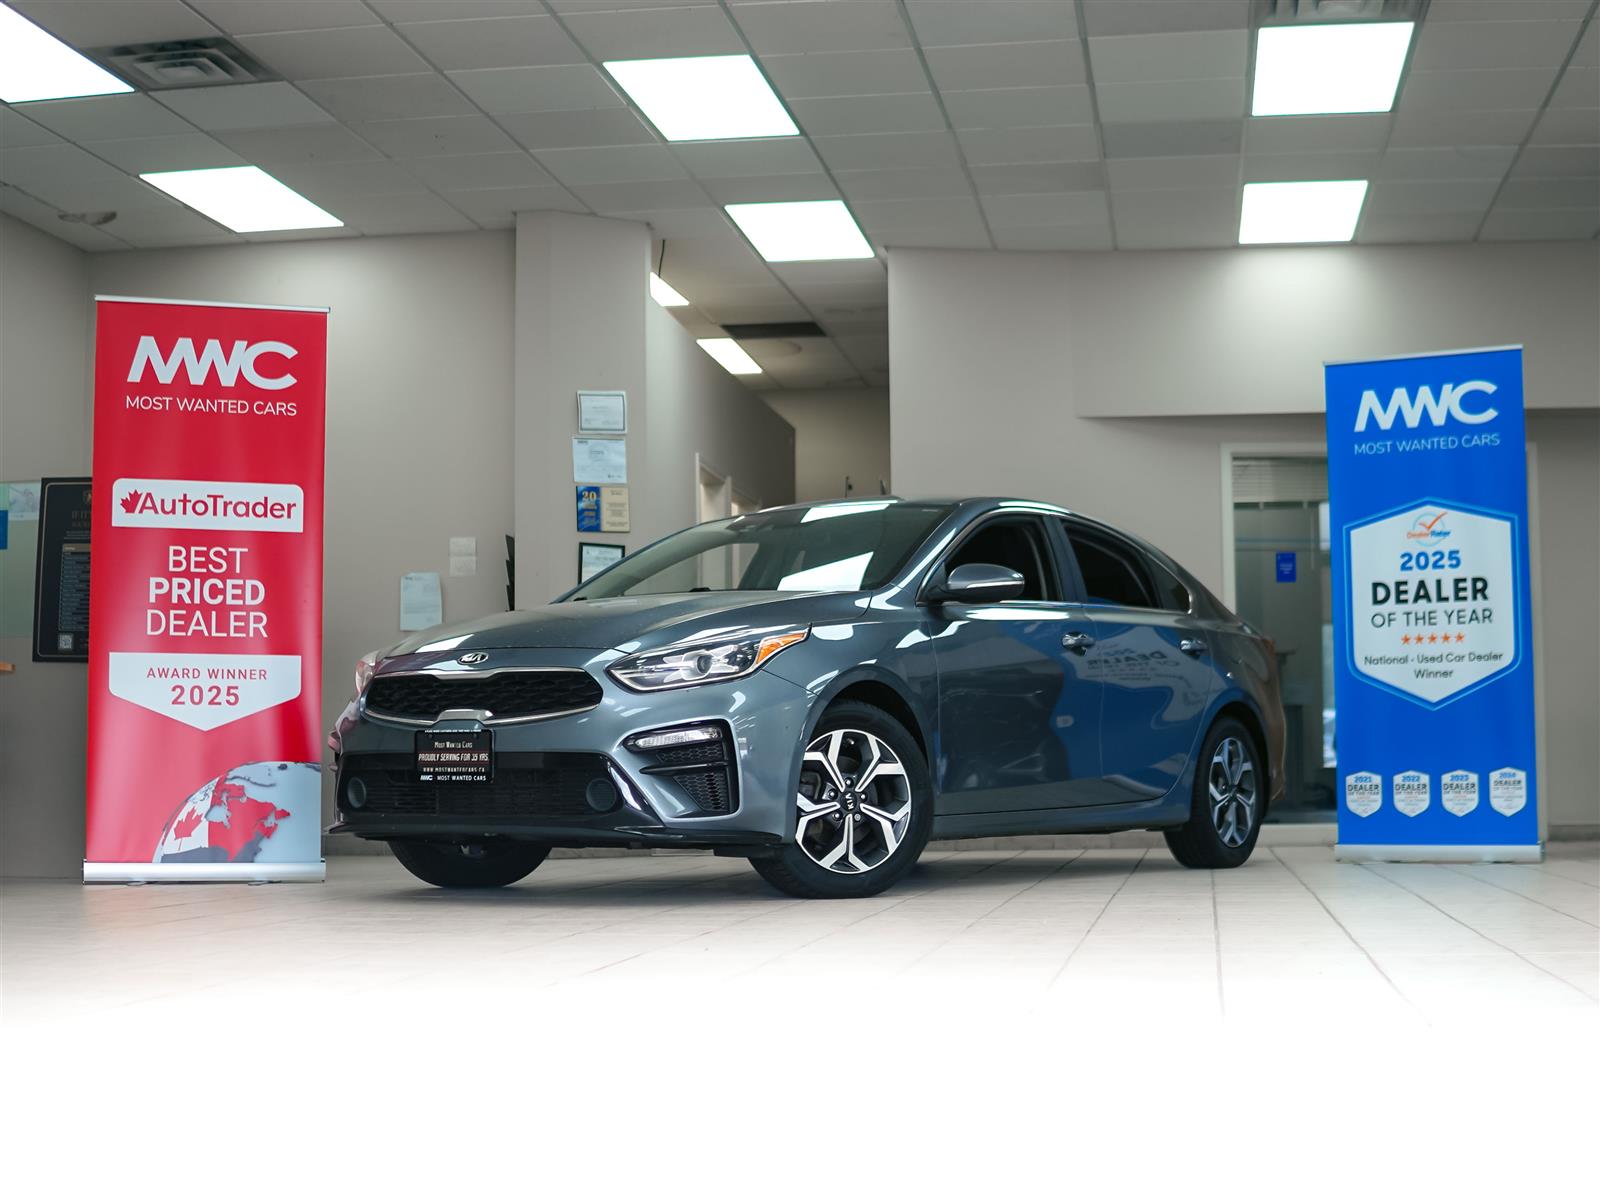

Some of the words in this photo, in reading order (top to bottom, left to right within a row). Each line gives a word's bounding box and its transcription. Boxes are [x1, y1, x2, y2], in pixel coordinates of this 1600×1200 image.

[127, 335, 298, 390] MWC
[126, 395, 173, 411] MOST
[176, 397, 249, 414] WANTED
[253, 401, 297, 416] CARS
[1354, 380, 1499, 433] MWC
[1354, 440, 1392, 456] MOST
[1396, 435, 1458, 453] WANTED
[1462, 432, 1501, 448] CARS
[138, 491, 297, 520] AutoTrader
[168, 545, 249, 574] BEST
[1400, 549, 1462, 572] 2025
[149, 577, 265, 606] PRICED
[1371, 577, 1489, 606] DEALER
[146, 609, 268, 638] DEALER
[1370, 612, 1397, 629] OF
[1402, 610, 1438, 627] THE
[1444, 608, 1493, 625] YEAR
[1364, 655, 1408, 666] National
[1417, 654, 1443, 664] Used
[1445, 653, 1465, 663] Car
[1468, 652, 1504, 662] Dealer
[146, 667, 201, 680] AWARD
[207, 668, 267, 681] WINNER
[1414, 669, 1454, 679] Winner
[171, 684, 240, 706] 2025
[1443, 783, 1476, 791] DEALER
